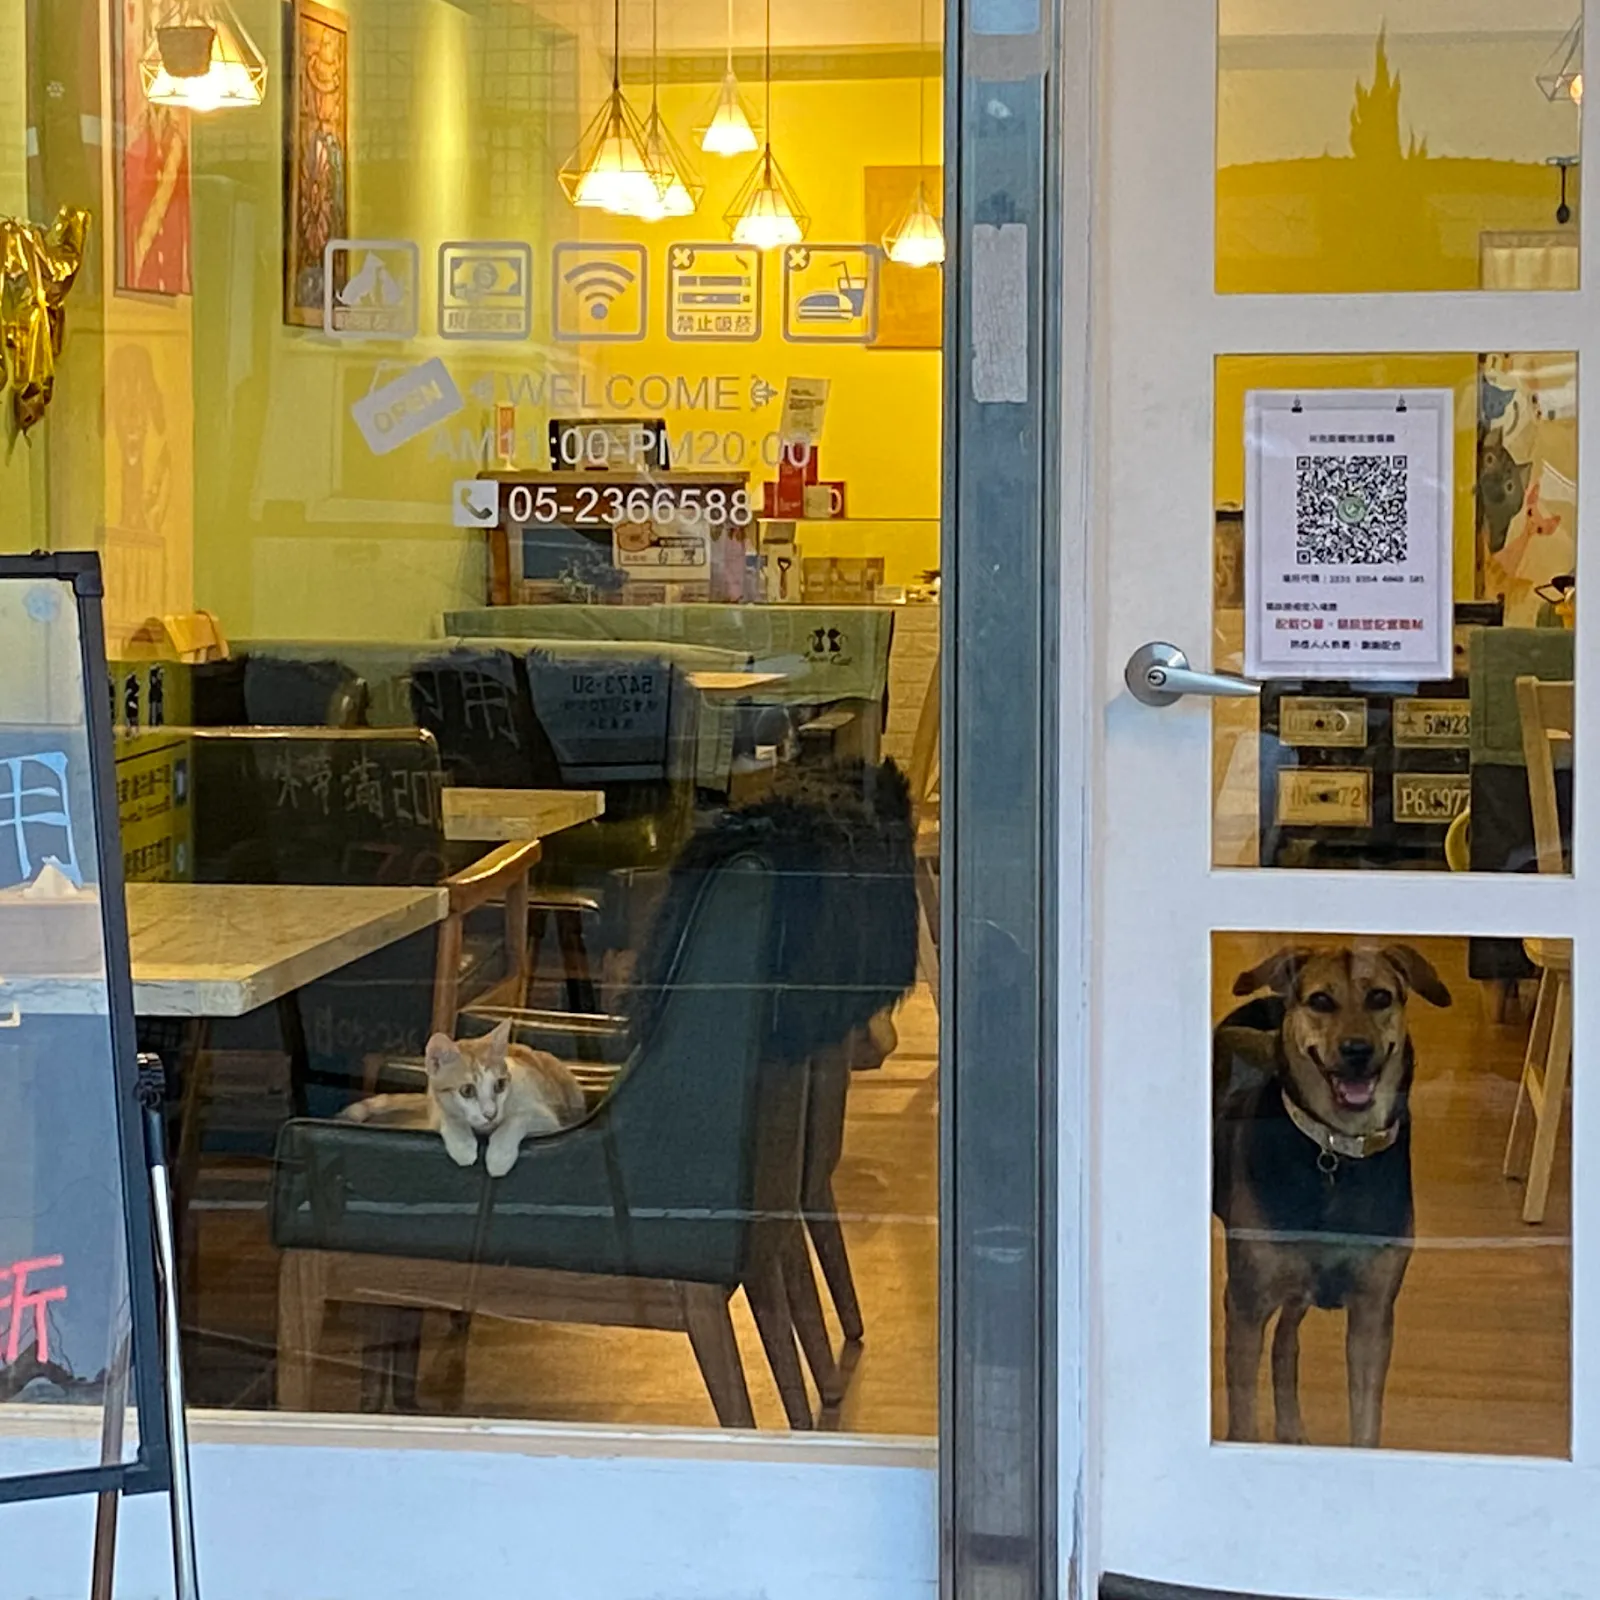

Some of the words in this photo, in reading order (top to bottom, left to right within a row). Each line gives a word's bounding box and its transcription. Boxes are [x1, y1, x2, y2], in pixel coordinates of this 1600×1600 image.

[373, 378, 444, 434] OPEN
[504, 374, 740, 411] WELCOME
[508, 485, 753, 526] 05-2366588
